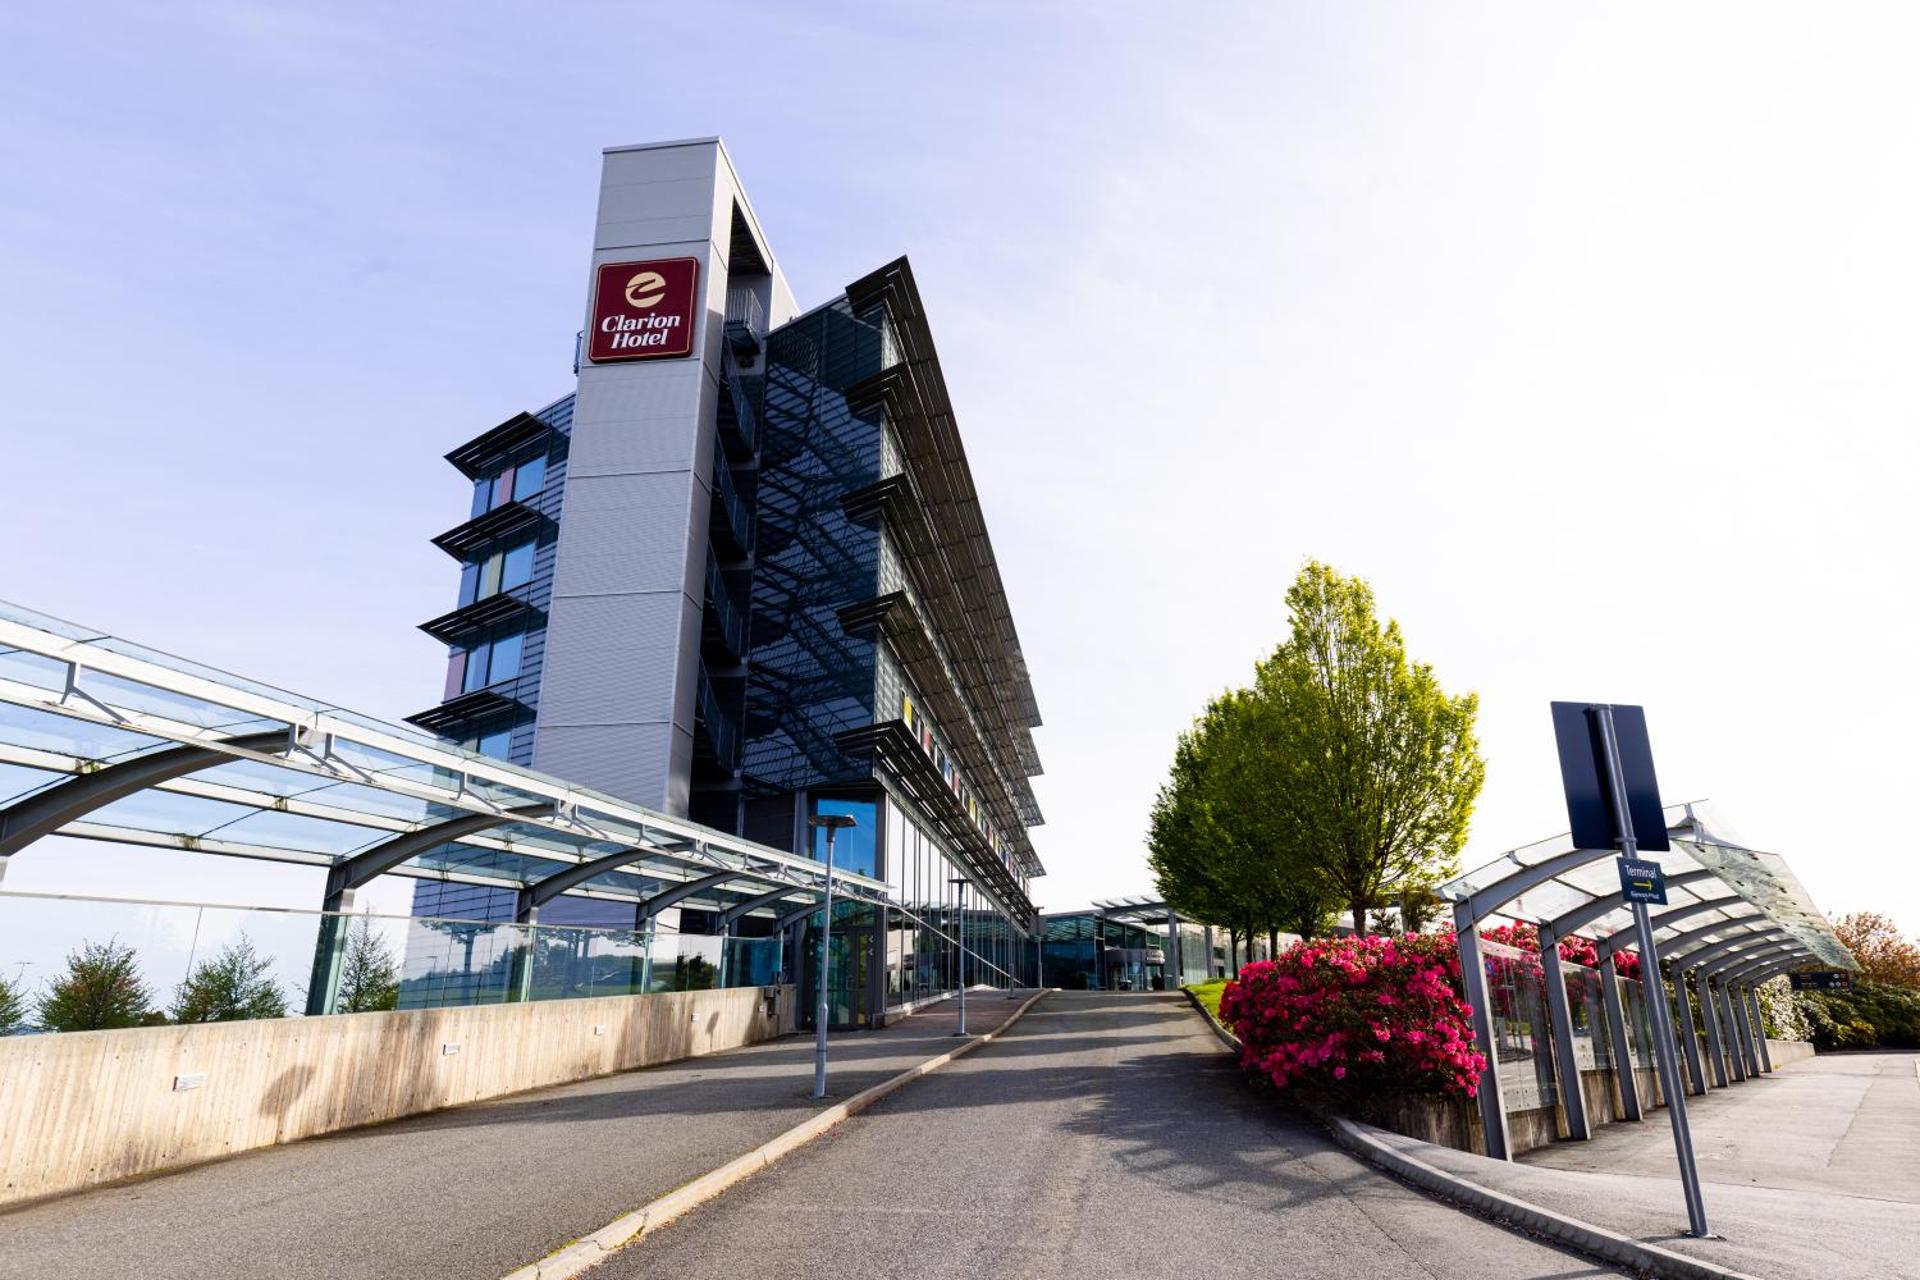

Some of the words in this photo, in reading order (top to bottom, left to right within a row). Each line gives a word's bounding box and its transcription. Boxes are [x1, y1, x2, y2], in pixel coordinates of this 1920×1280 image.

[601, 313, 680, 332] Clarion
[610, 329, 668, 349] Hotel
[1624, 864, 1657, 878] Terminal
